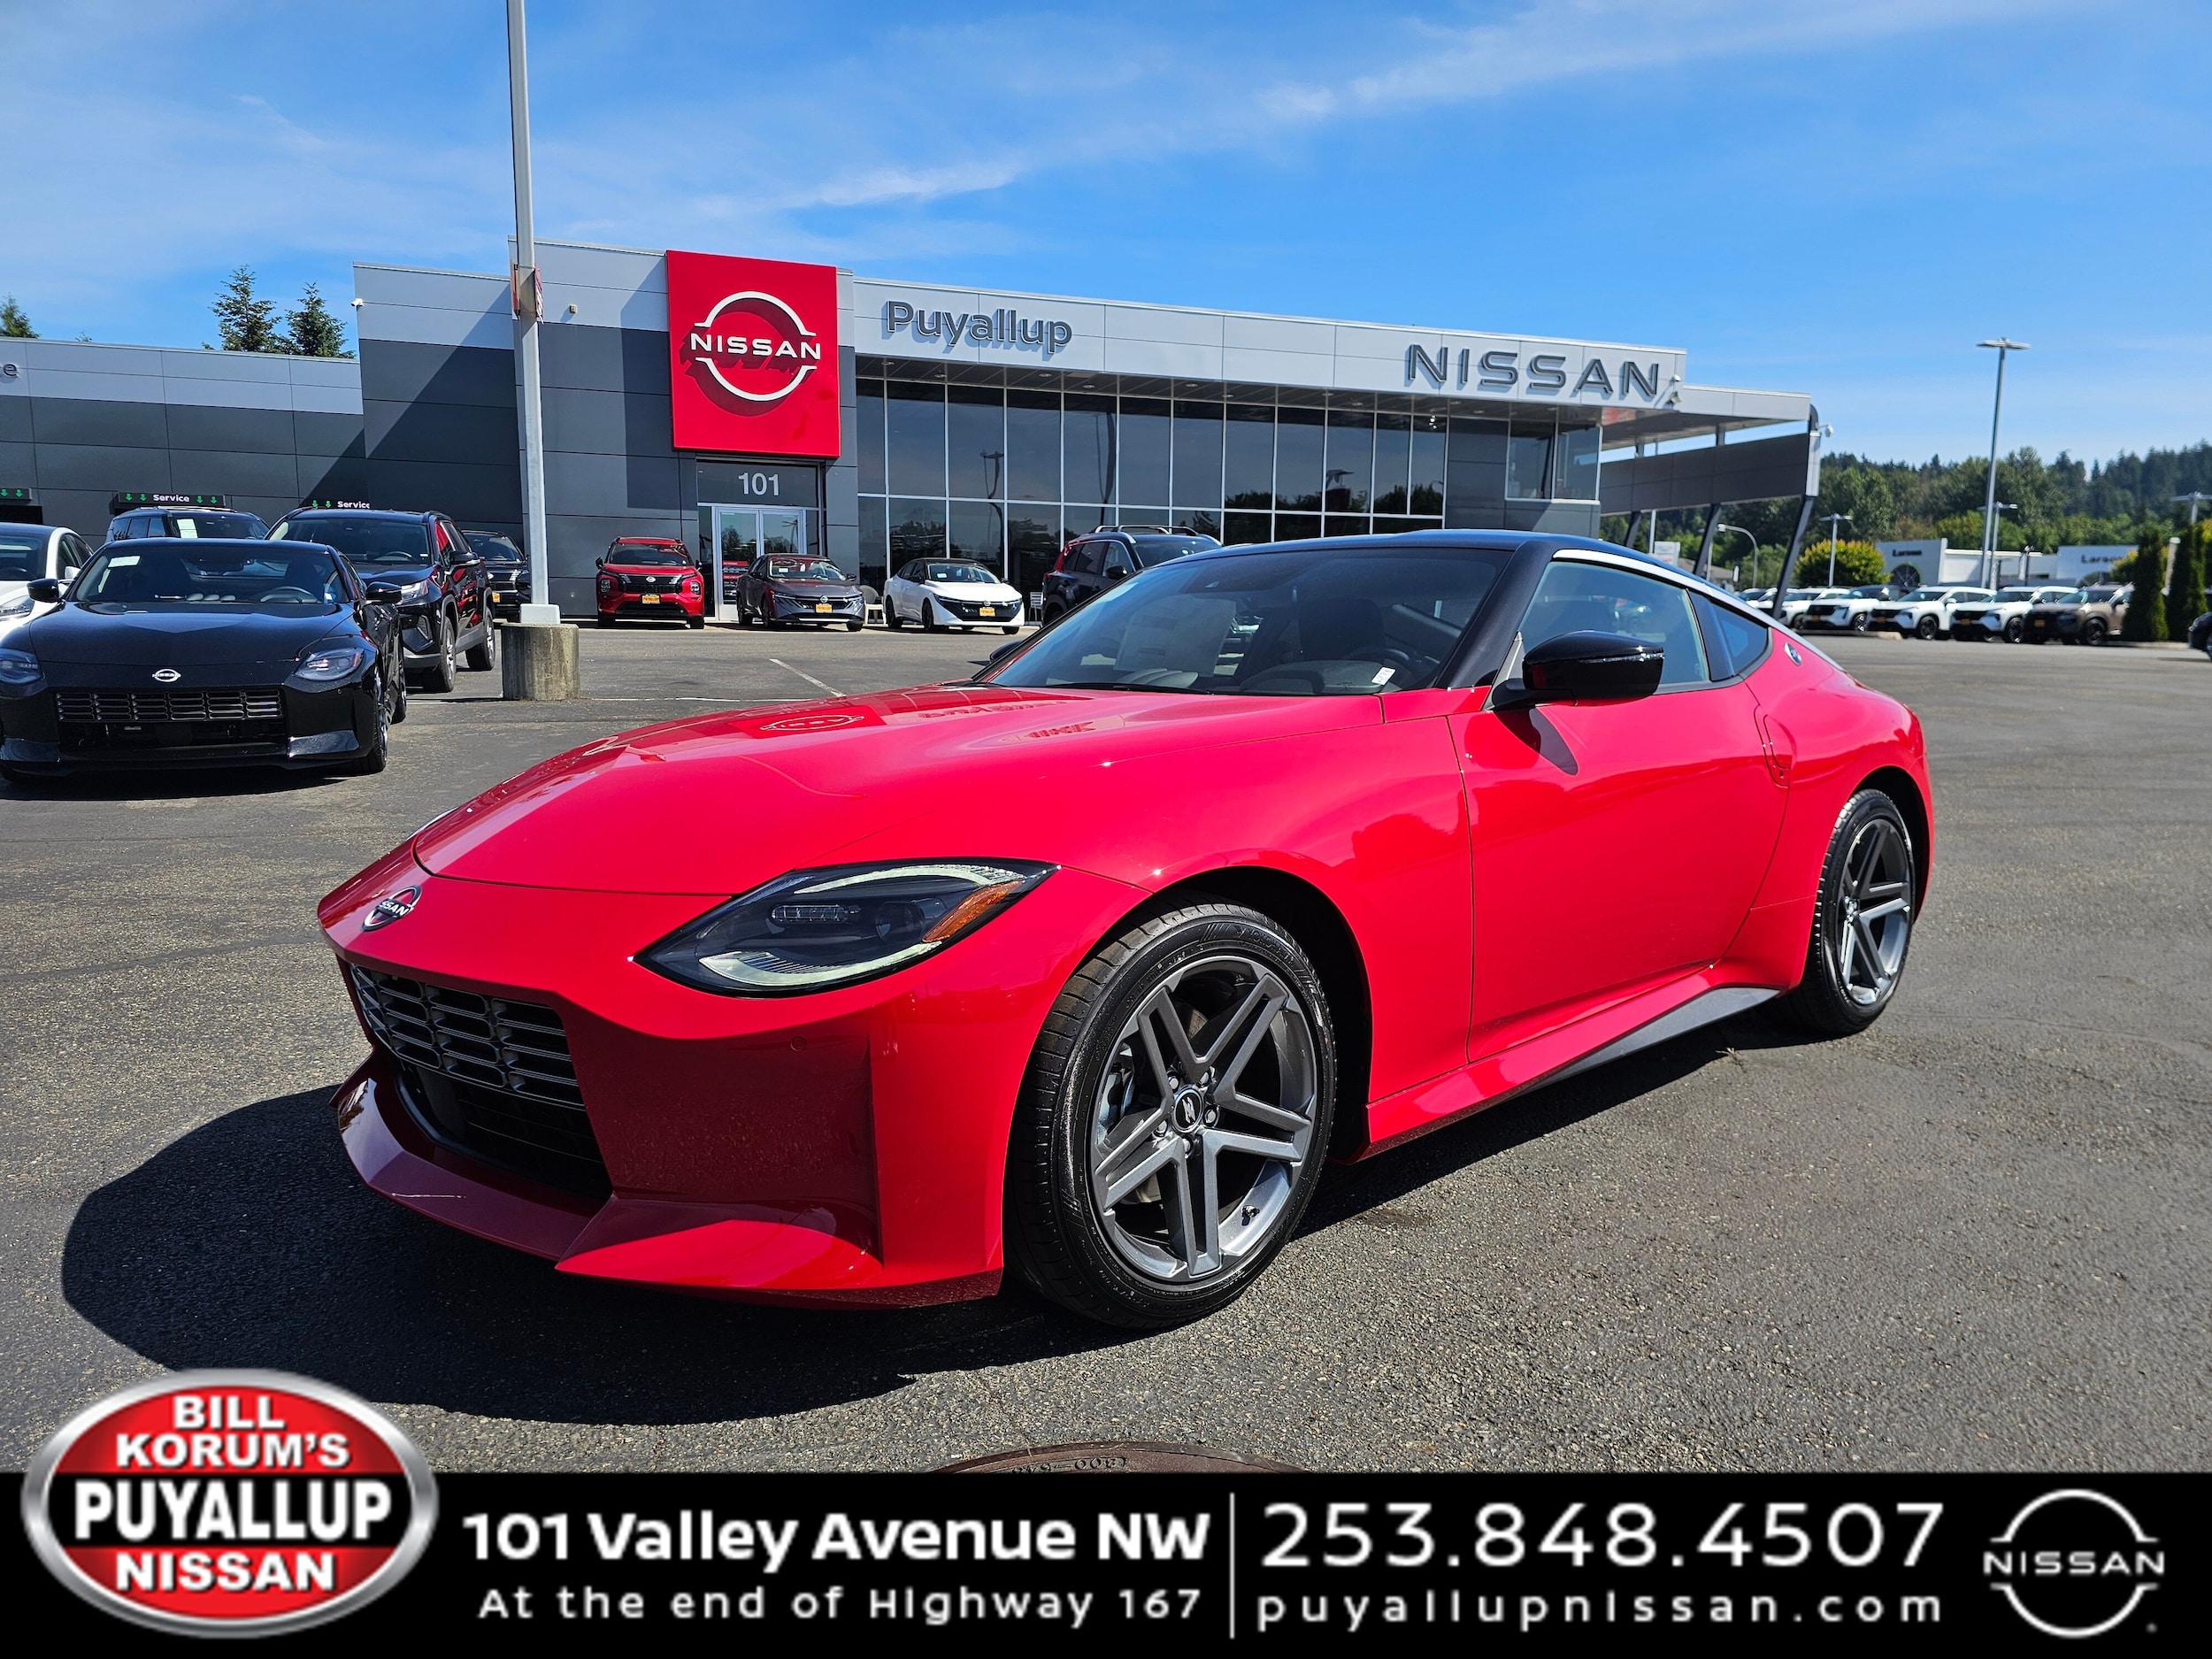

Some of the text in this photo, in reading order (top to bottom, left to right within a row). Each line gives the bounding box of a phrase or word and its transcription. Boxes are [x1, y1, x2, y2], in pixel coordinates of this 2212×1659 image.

[886, 300, 1073, 355] Puyallup
[690, 332, 822, 361] NISSAN
[1408, 343, 1660, 398] NISSAN
[152, 494, 190, 503] Service
[738, 472, 780, 496] 101
